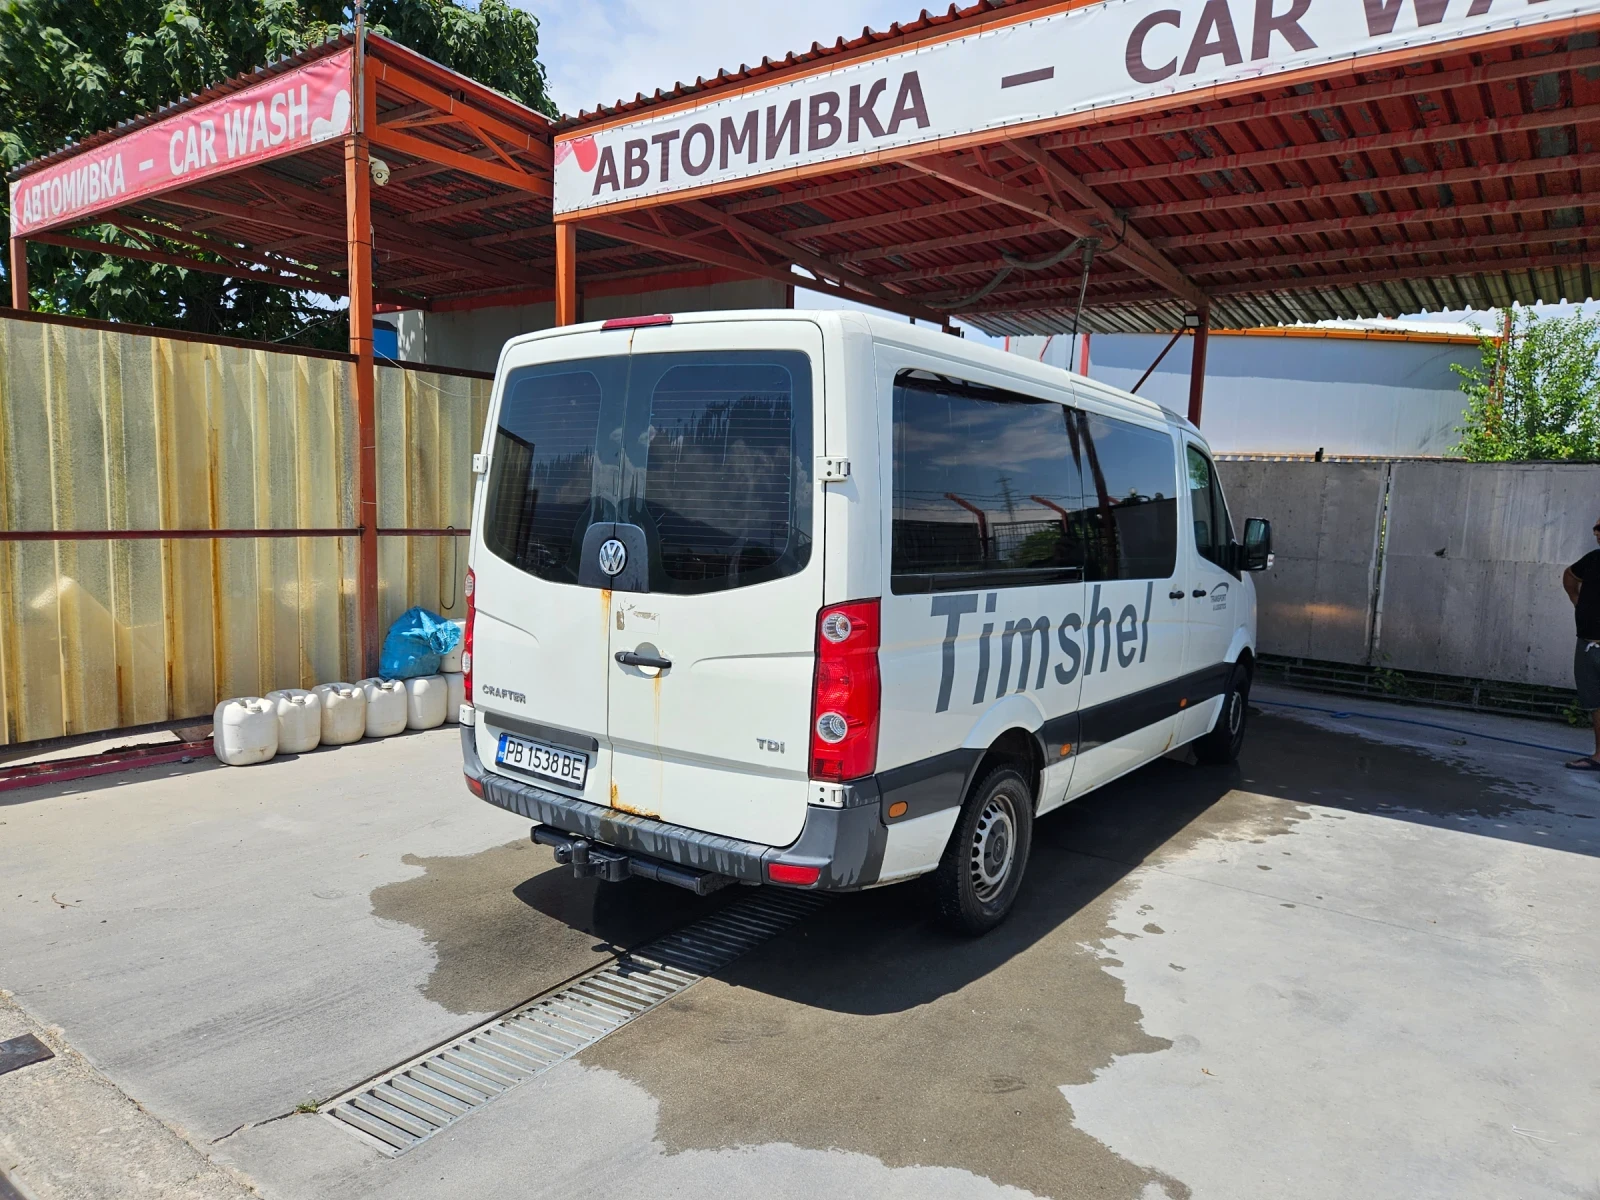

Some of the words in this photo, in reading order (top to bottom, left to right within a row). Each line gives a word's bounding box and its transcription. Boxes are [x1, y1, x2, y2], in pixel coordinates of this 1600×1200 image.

[22, 153, 125, 226] АВТОМИВКА
[169, 120, 218, 176] CAR
[223, 84, 309, 159] WASH
[592, 70, 931, 196] АВТОМИВКА
[1125, 0, 1318, 85] CAR
[482, 684, 526, 704] CRAFTER
[930, 581, 1154, 714] Timshel
[528, 745, 560, 774] 1538
